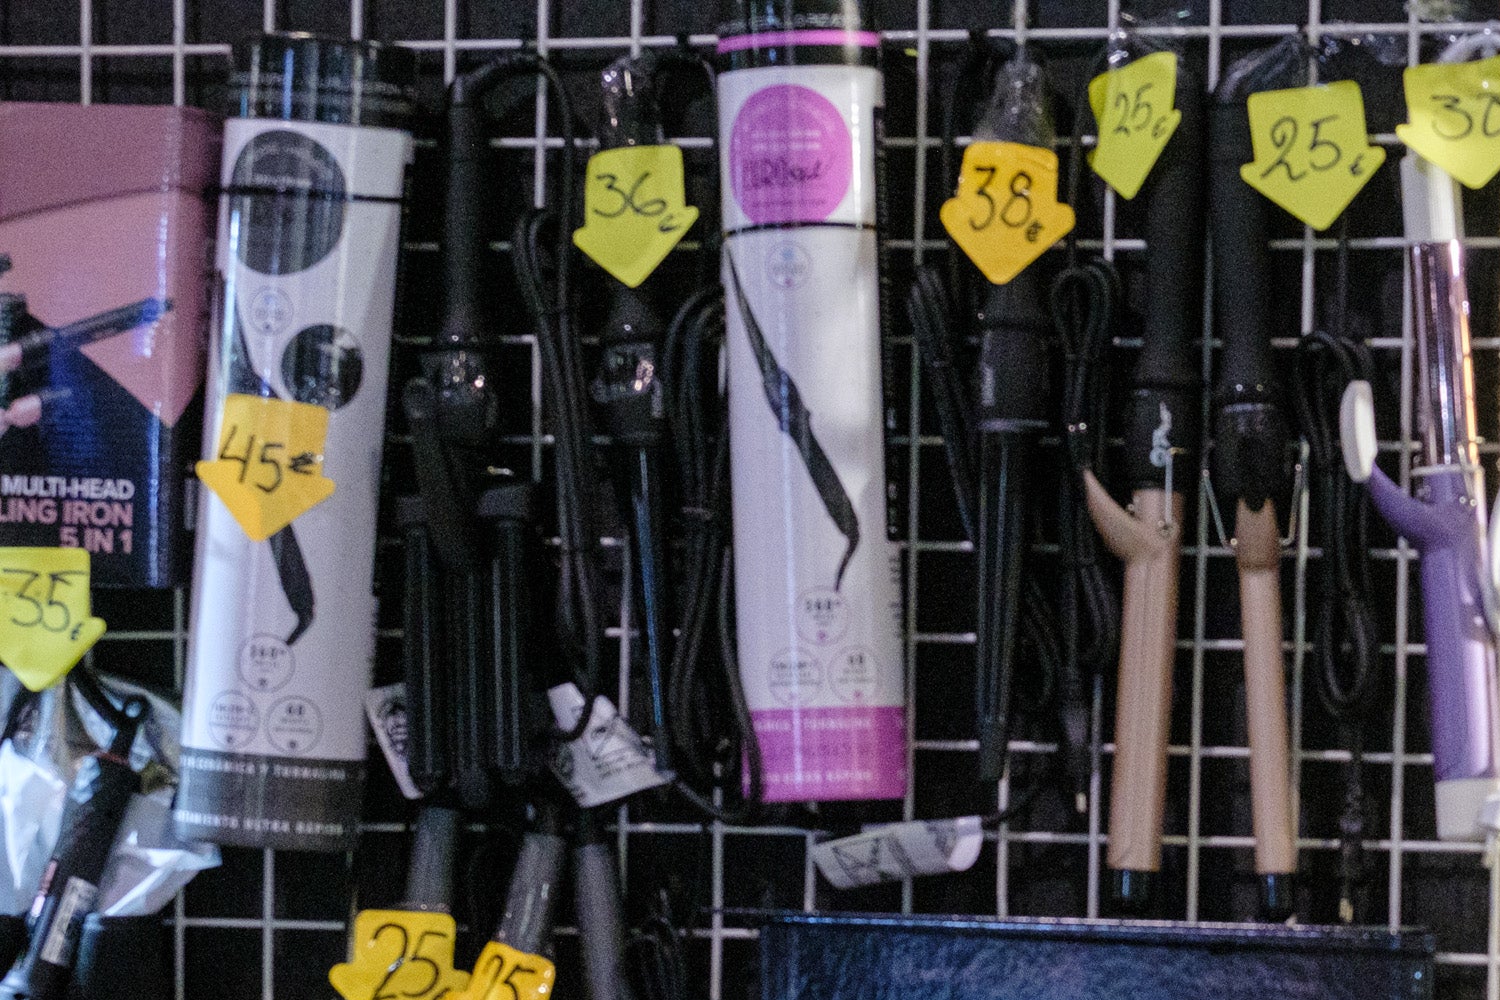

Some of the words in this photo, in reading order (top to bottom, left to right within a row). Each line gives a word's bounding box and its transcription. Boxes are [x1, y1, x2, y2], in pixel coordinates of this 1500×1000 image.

[0, 474, 136, 501] MULTI-HEAD
[62, 500, 134, 528] IRON
[60, 526, 80, 548] 5
[84, 528, 114, 555] IN
[119, 528, 134, 555] 1
